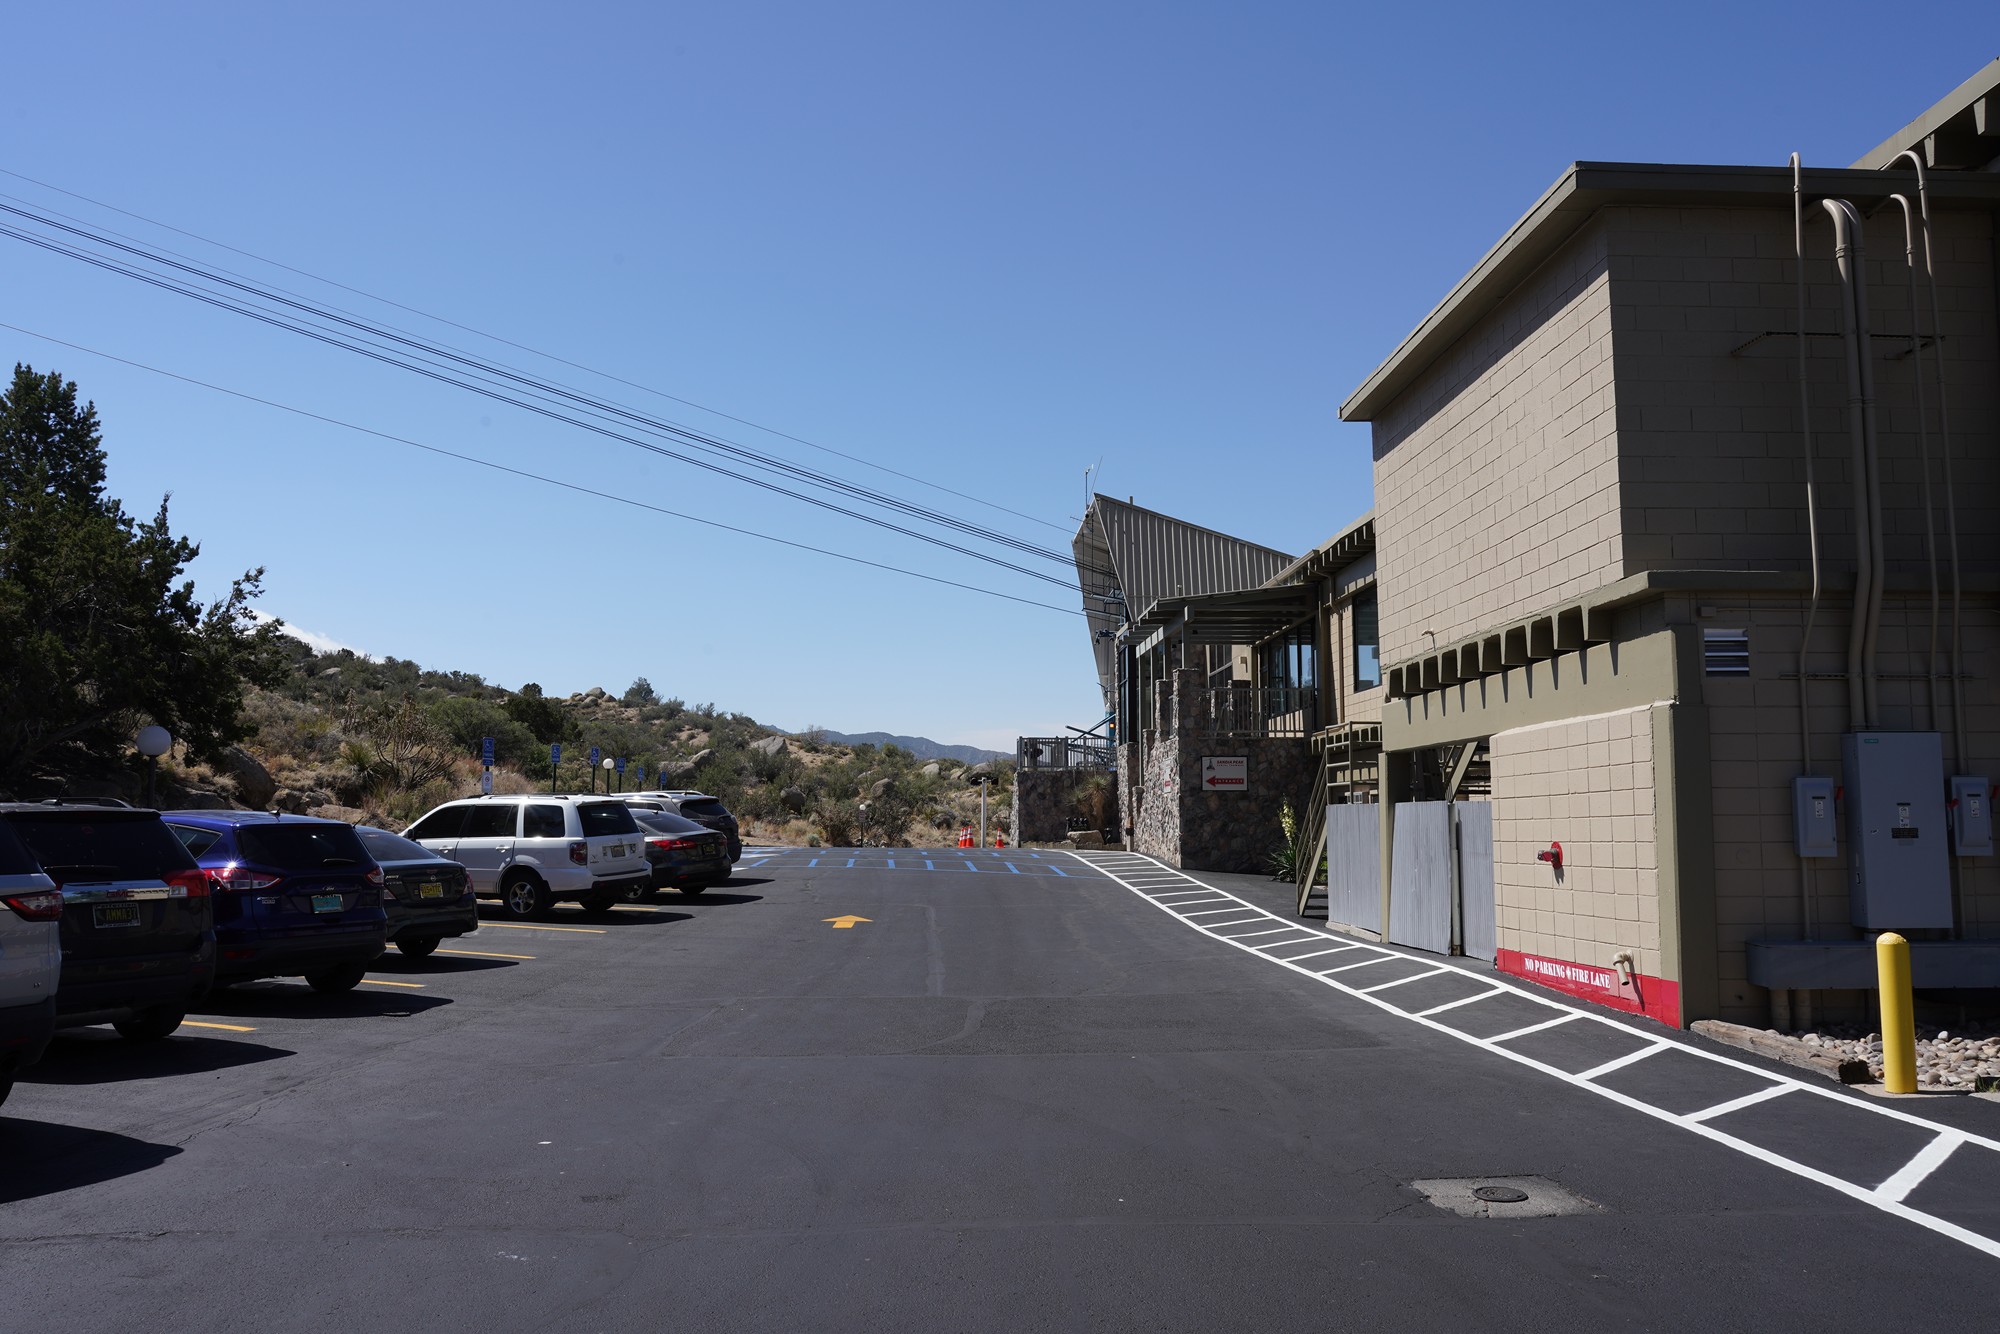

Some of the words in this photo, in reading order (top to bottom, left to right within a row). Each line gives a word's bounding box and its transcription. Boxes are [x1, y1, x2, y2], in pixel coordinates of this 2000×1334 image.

[107, 890, 134, 898] GMC
[1525, 958, 1534, 971] NO
[1535, 960, 1565, 978] PARKING
[1572, 967, 1589, 983] FIRE
[1590, 971, 1611, 988] LANE
